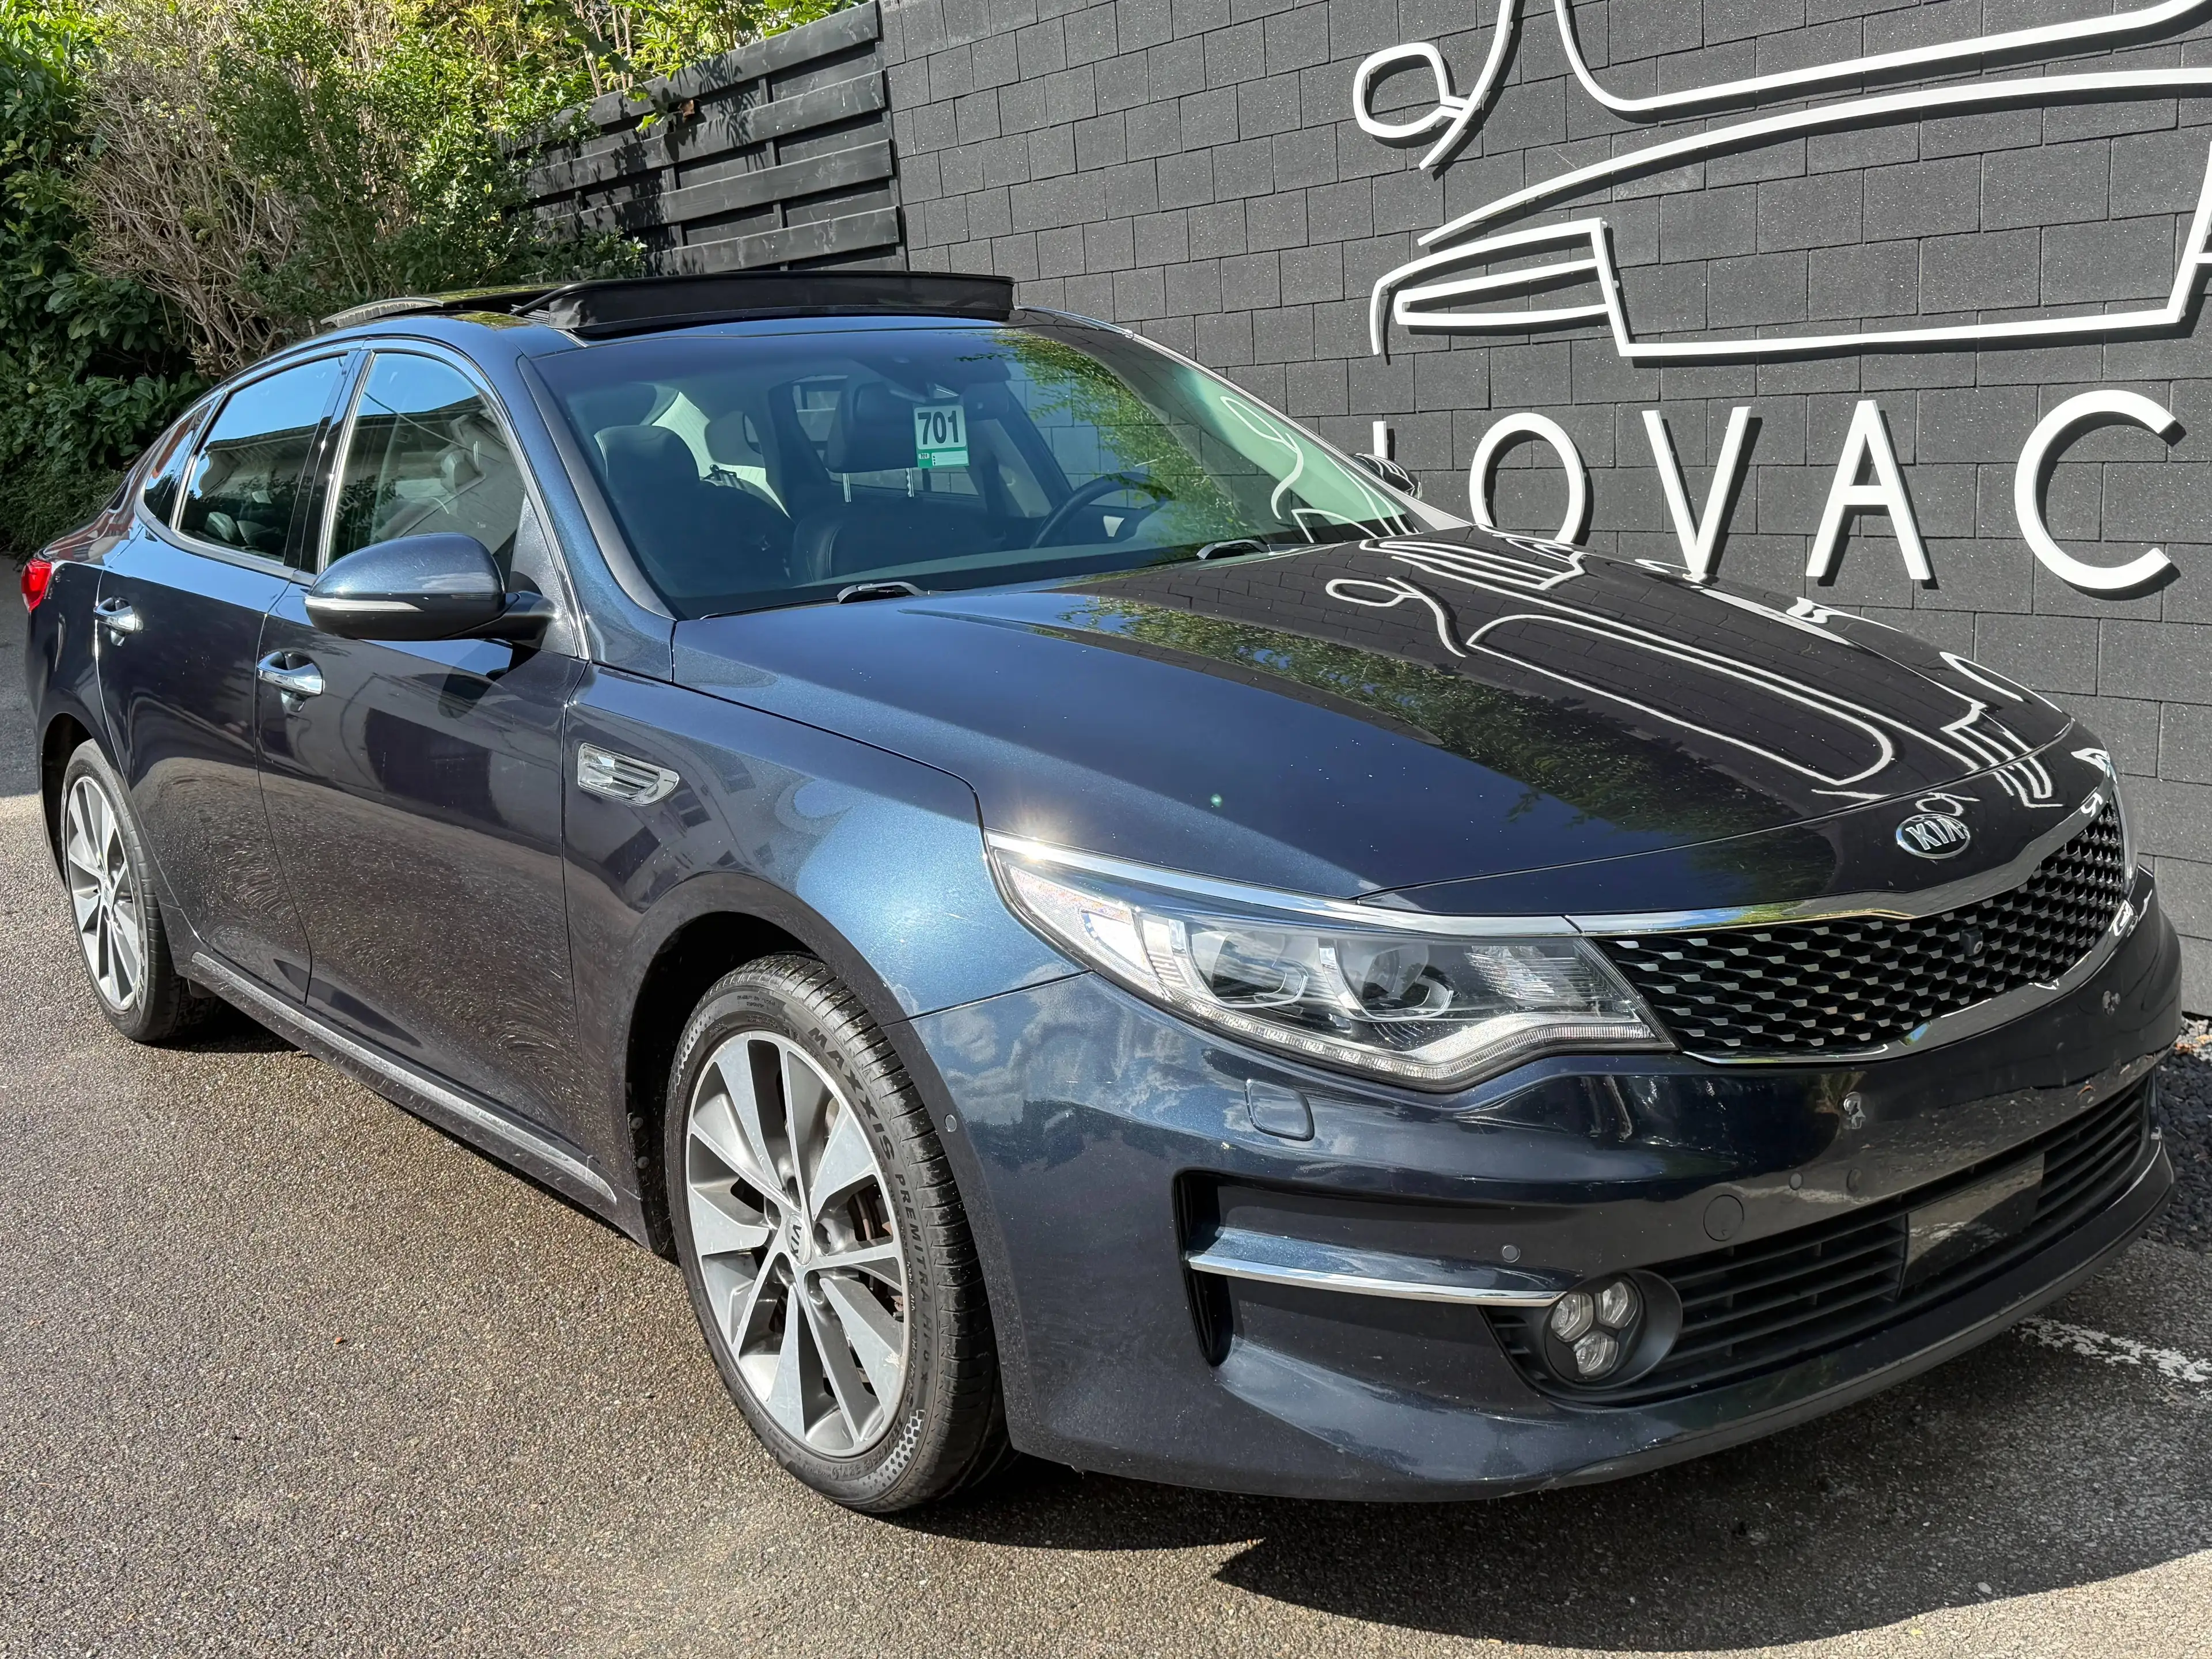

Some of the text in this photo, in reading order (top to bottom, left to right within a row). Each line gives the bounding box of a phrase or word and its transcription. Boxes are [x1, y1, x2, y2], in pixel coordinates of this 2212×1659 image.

[918, 410, 959, 445] 701
[1373, 390, 2176, 589] OVAC
[1905, 818, 1966, 851] KIA
[808, 1027, 895, 1160] MAXXIS
[895, 1173, 931, 1302] PREMITRA
[790, 1224, 802, 1260] KIA
